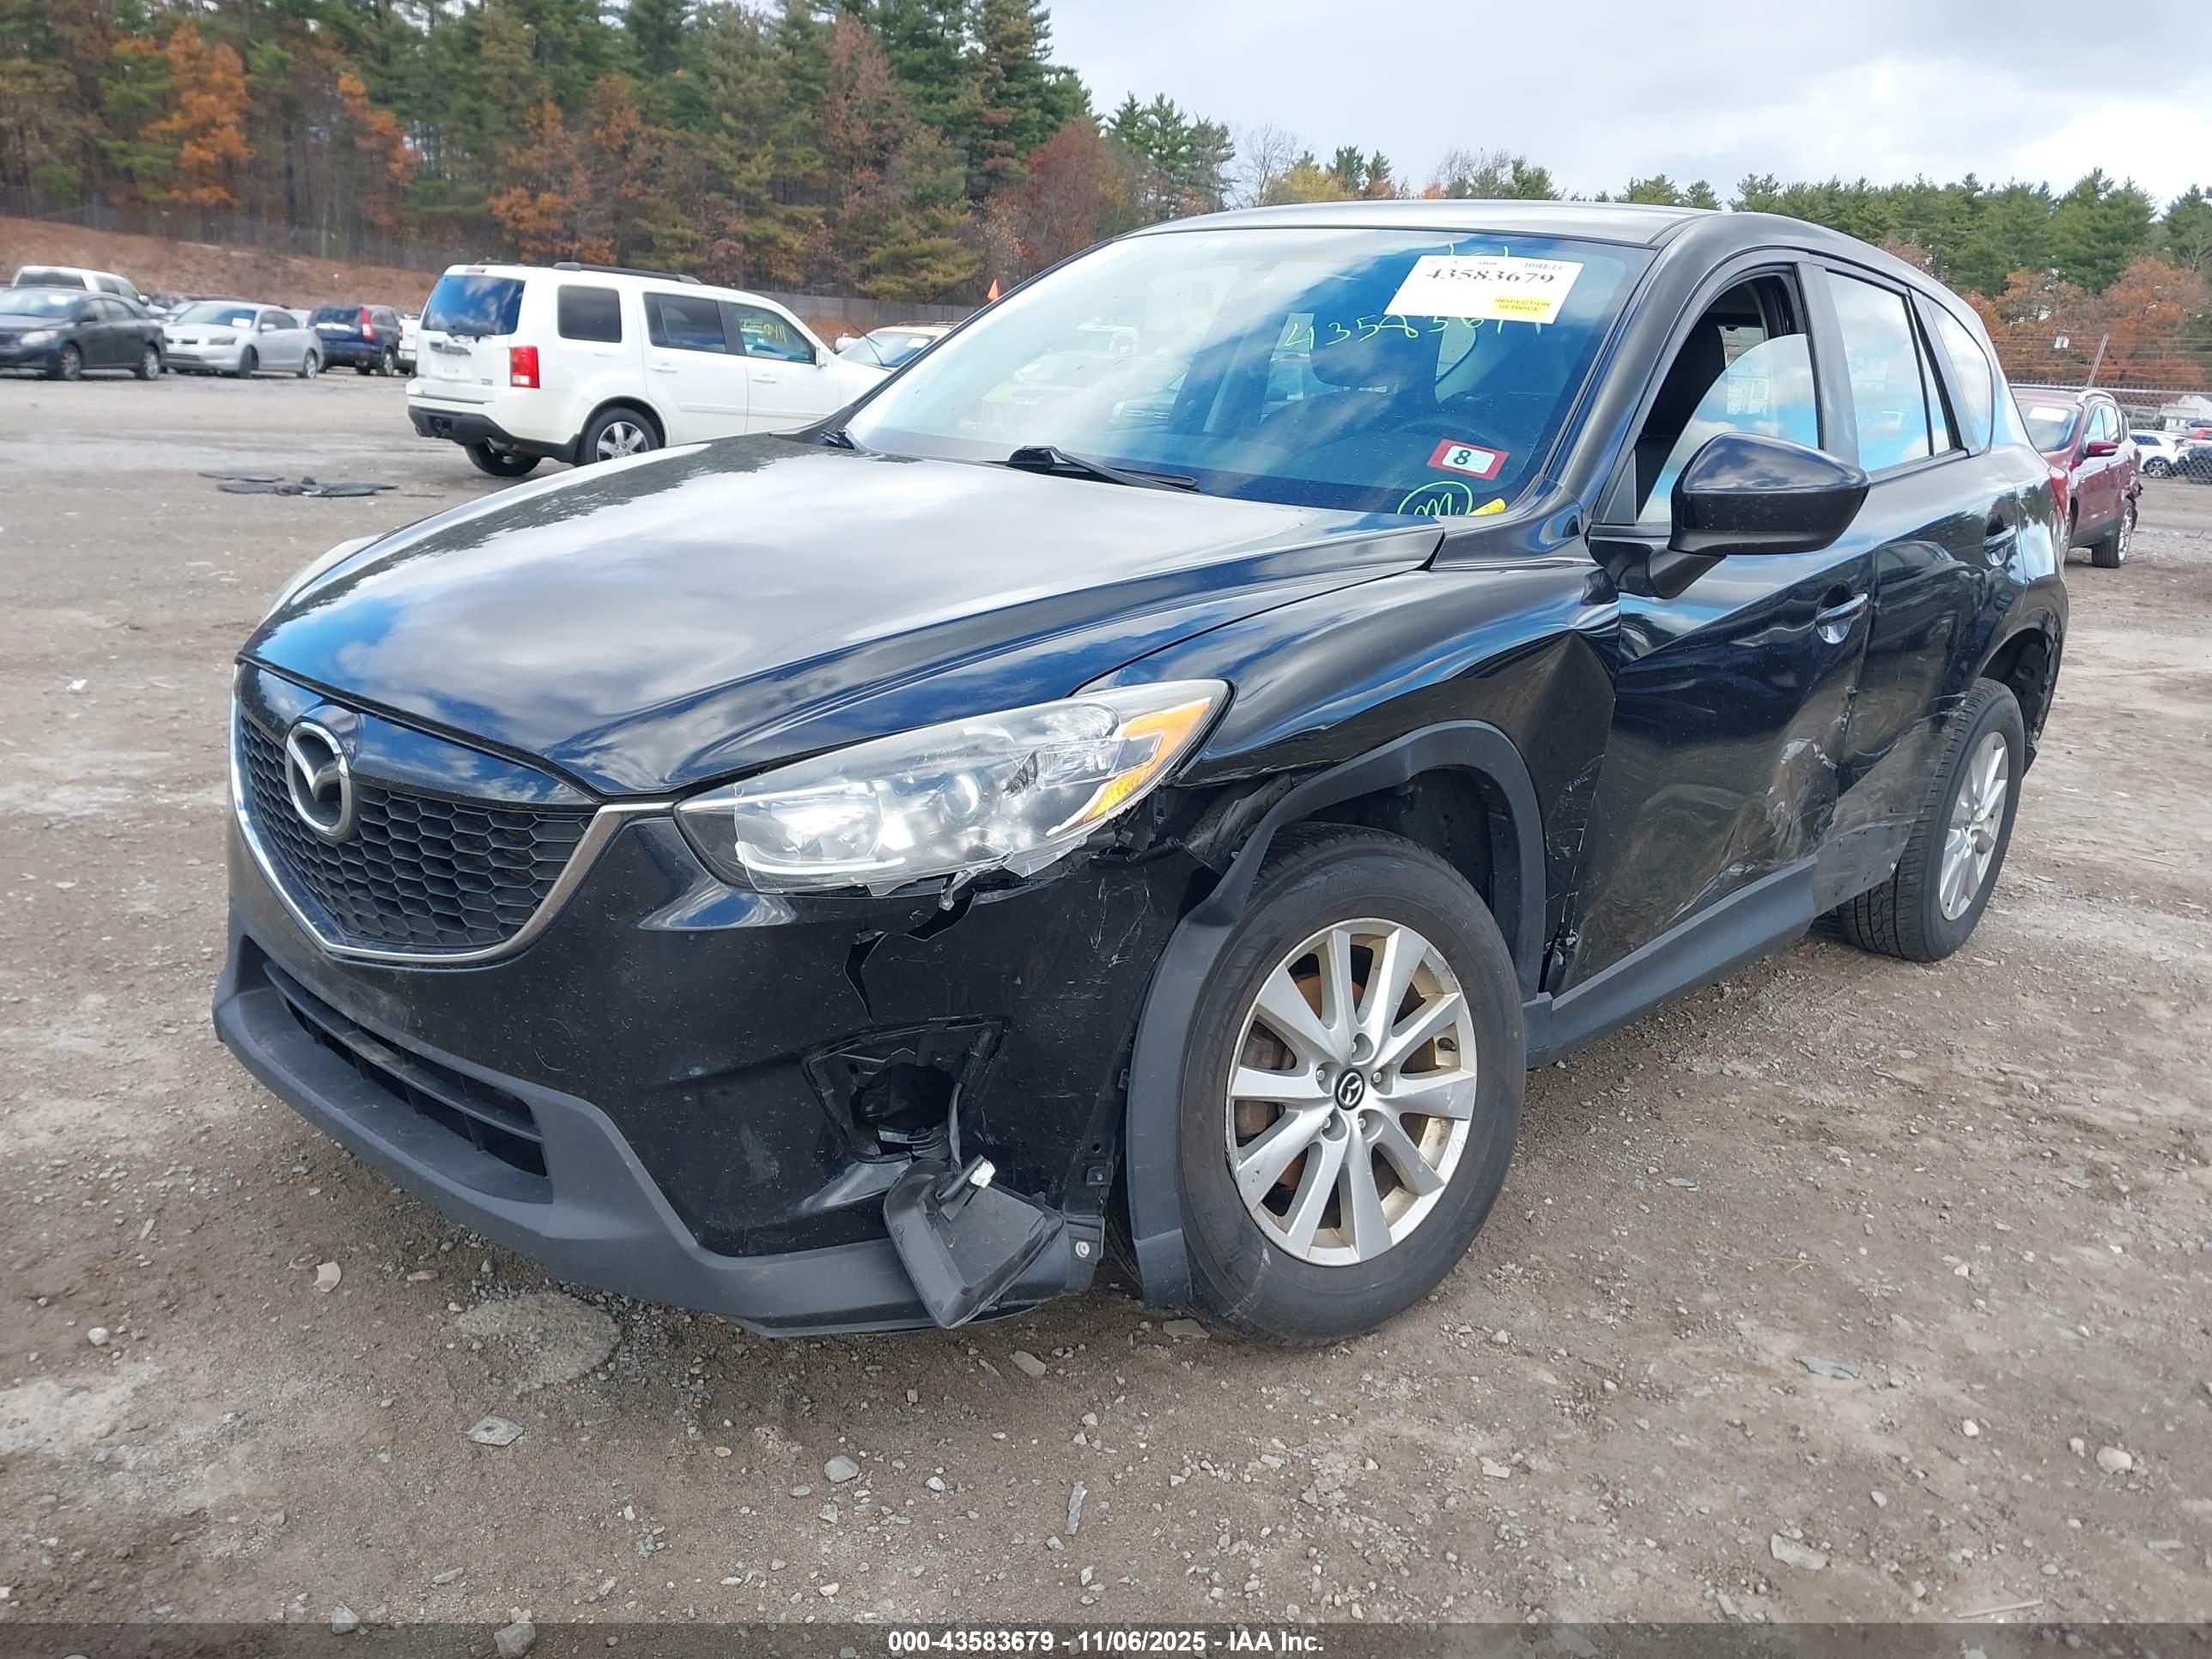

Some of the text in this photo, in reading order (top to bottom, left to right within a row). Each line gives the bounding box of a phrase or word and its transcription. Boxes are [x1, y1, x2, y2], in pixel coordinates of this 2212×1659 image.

[1425, 268, 1555, 283] 43583679
[1494, 297, 1552, 307] INSPECTION
[1498, 304, 1540, 313] SERVICE
[1453, 449, 1472, 465] 8
